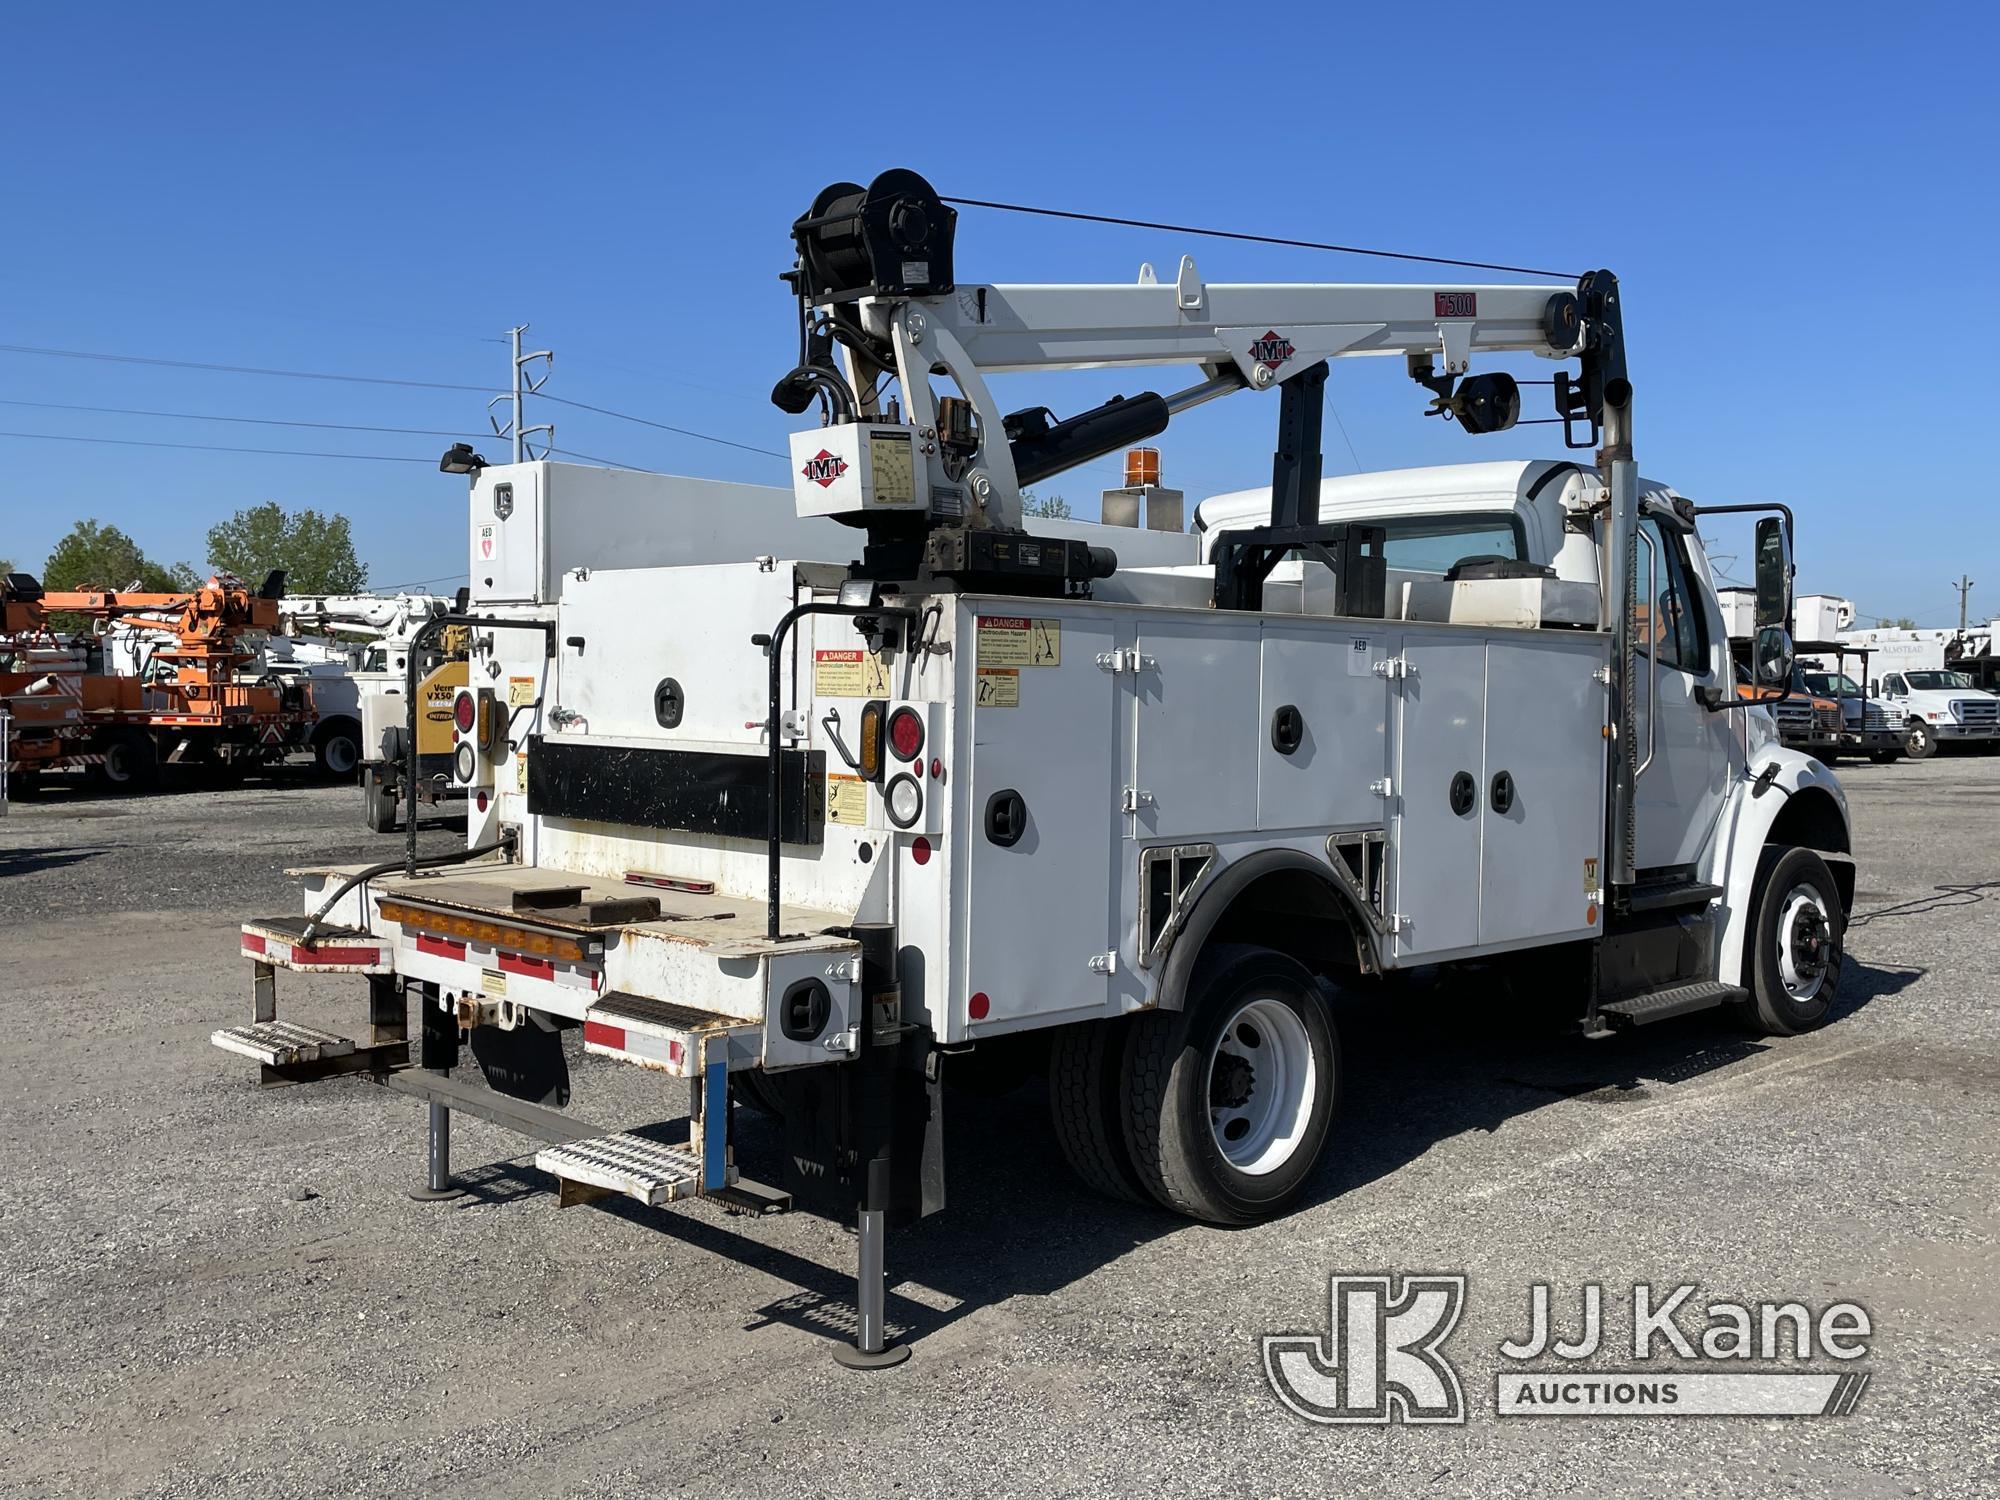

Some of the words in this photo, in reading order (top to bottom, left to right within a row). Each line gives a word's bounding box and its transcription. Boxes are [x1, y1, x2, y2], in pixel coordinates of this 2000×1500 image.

[1439, 294, 1472, 316] 7500
[1253, 340, 1290, 361] IMT
[806, 457, 843, 480] IMT
[482, 528, 492, 537] AED
[993, 618, 1024, 628] DANGER
[1353, 640, 1367, 651] AED
[829, 652, 857, 660] DANGER
